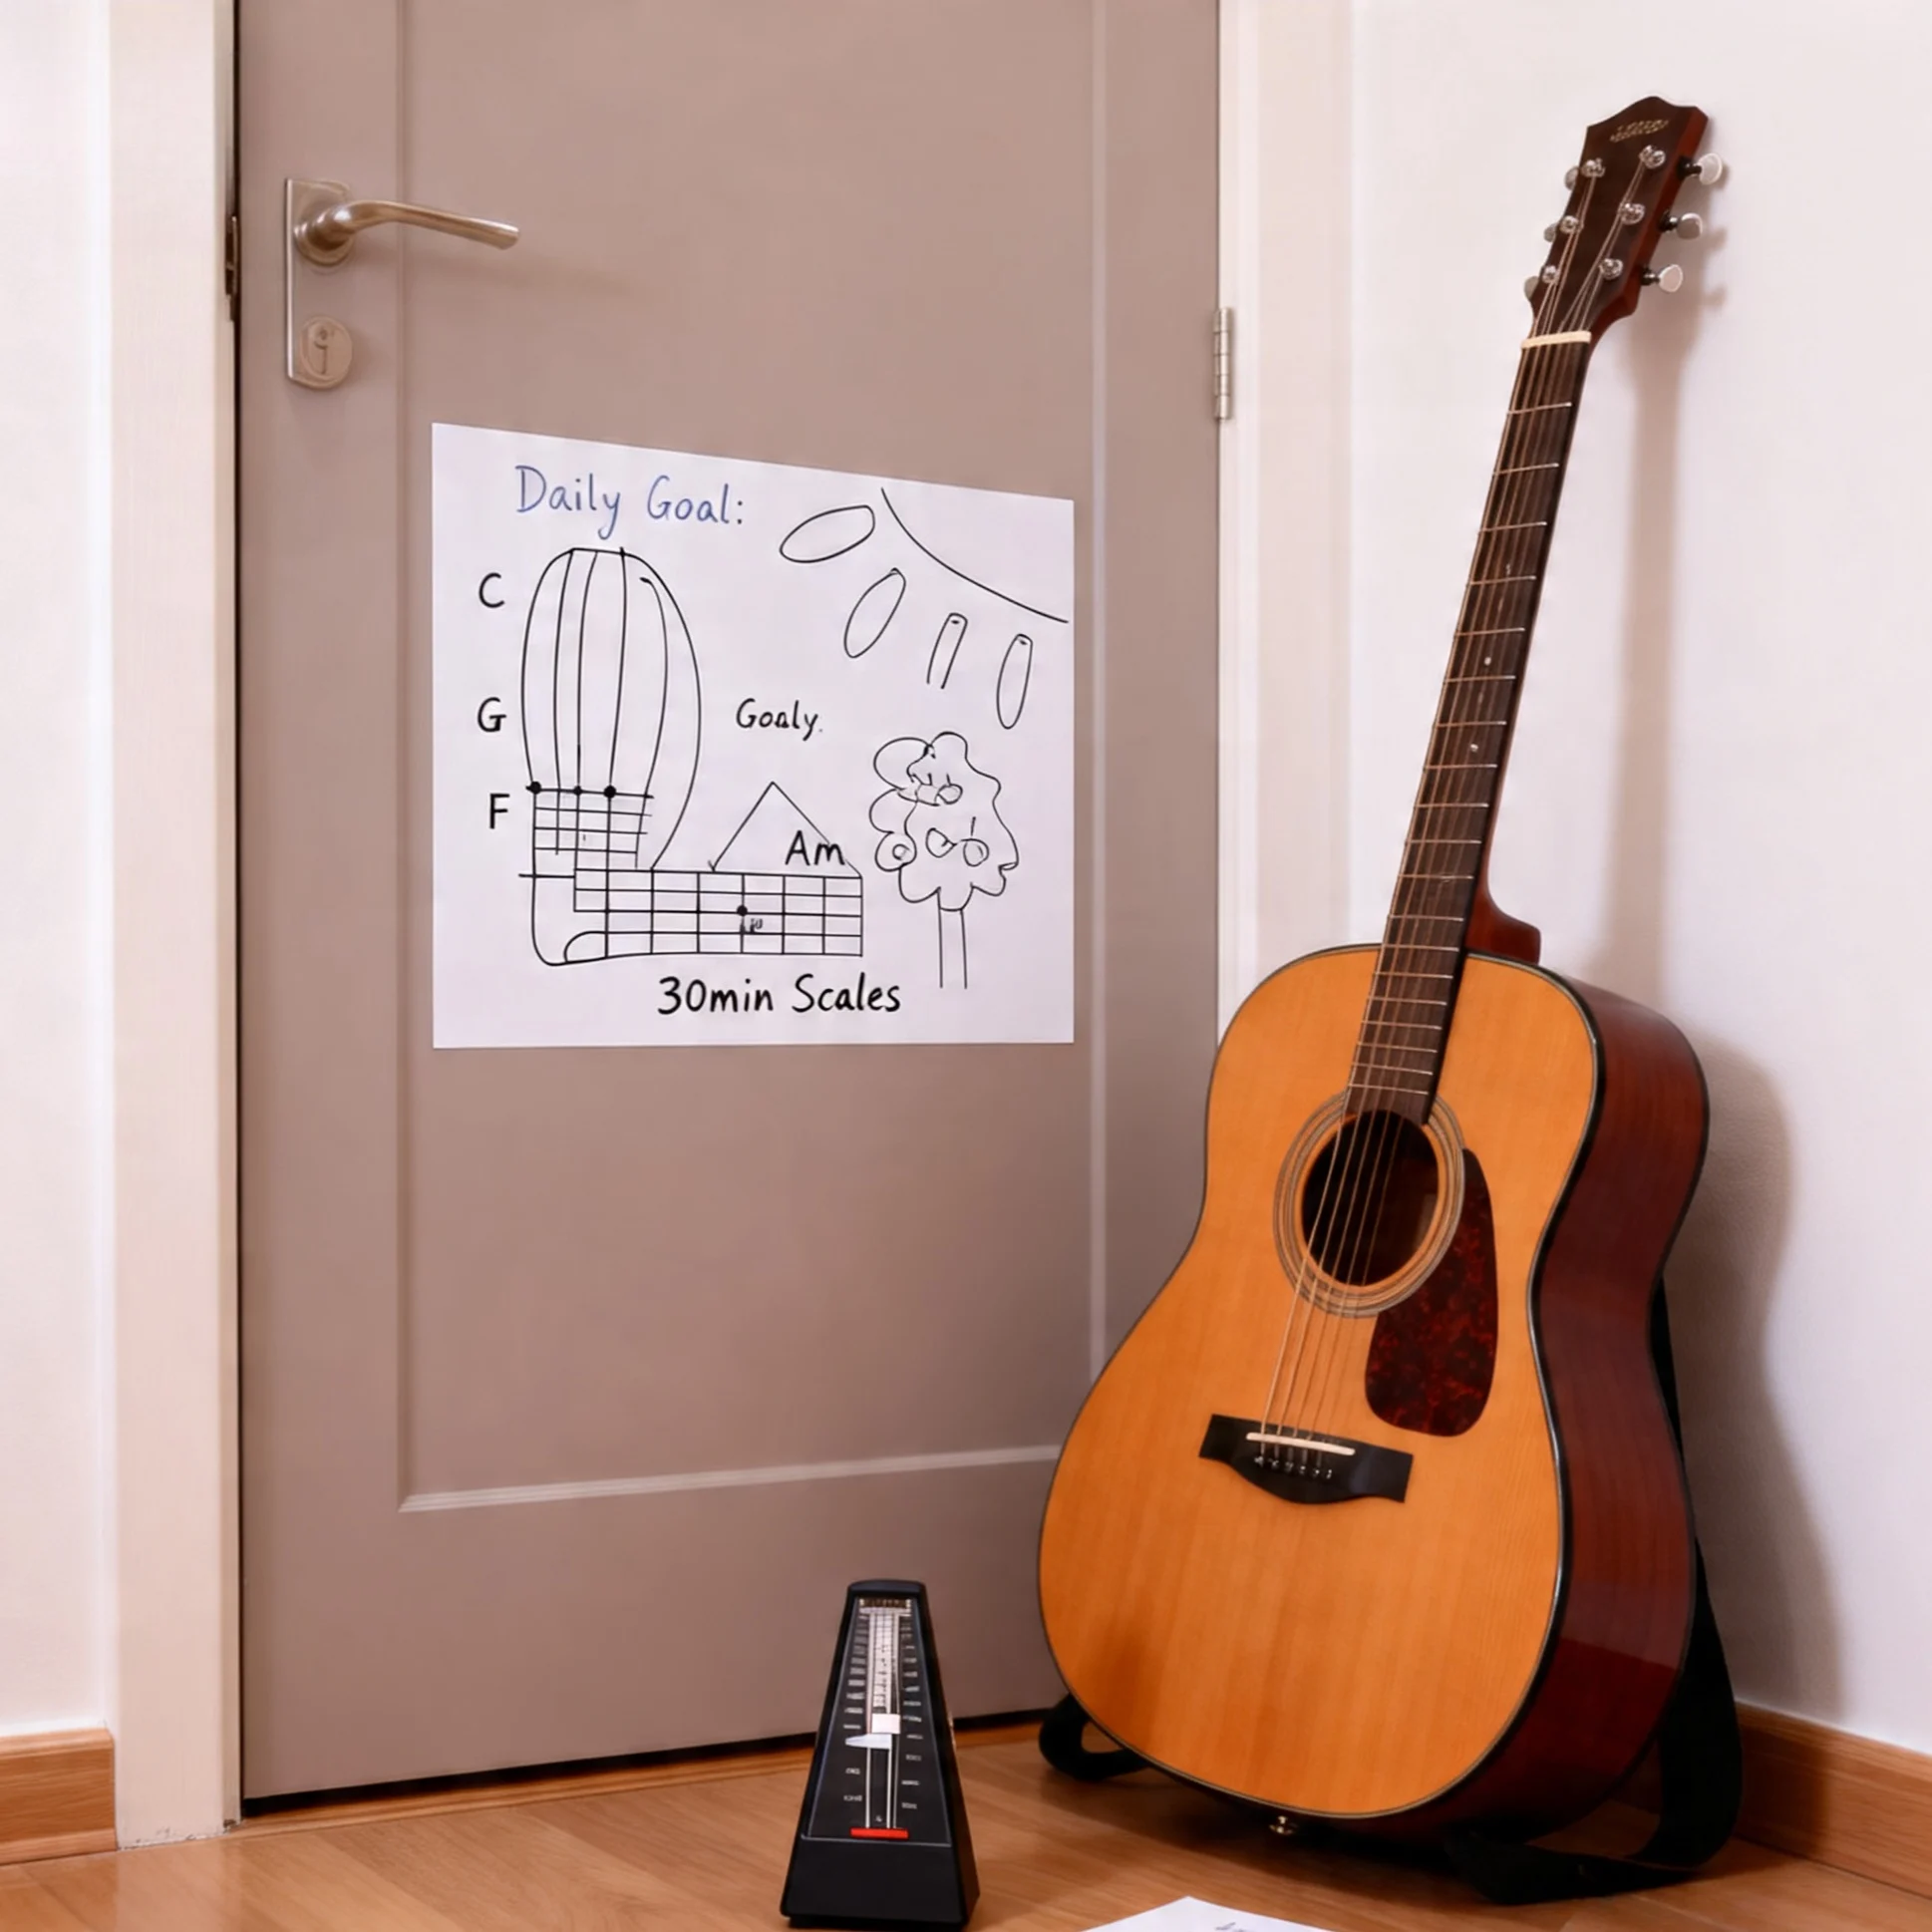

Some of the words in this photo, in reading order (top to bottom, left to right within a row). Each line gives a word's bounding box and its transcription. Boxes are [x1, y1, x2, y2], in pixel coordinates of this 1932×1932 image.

[515, 465, 621, 539] Daily
[647, 476, 743, 524] Goal:
[478, 572, 504, 608] C
[477, 697, 506, 733] G
[488, 794, 509, 829] F
[785, 830, 845, 866] Am
[658, 976, 775, 1015] 30min
[792, 972, 900, 1014] Scales
